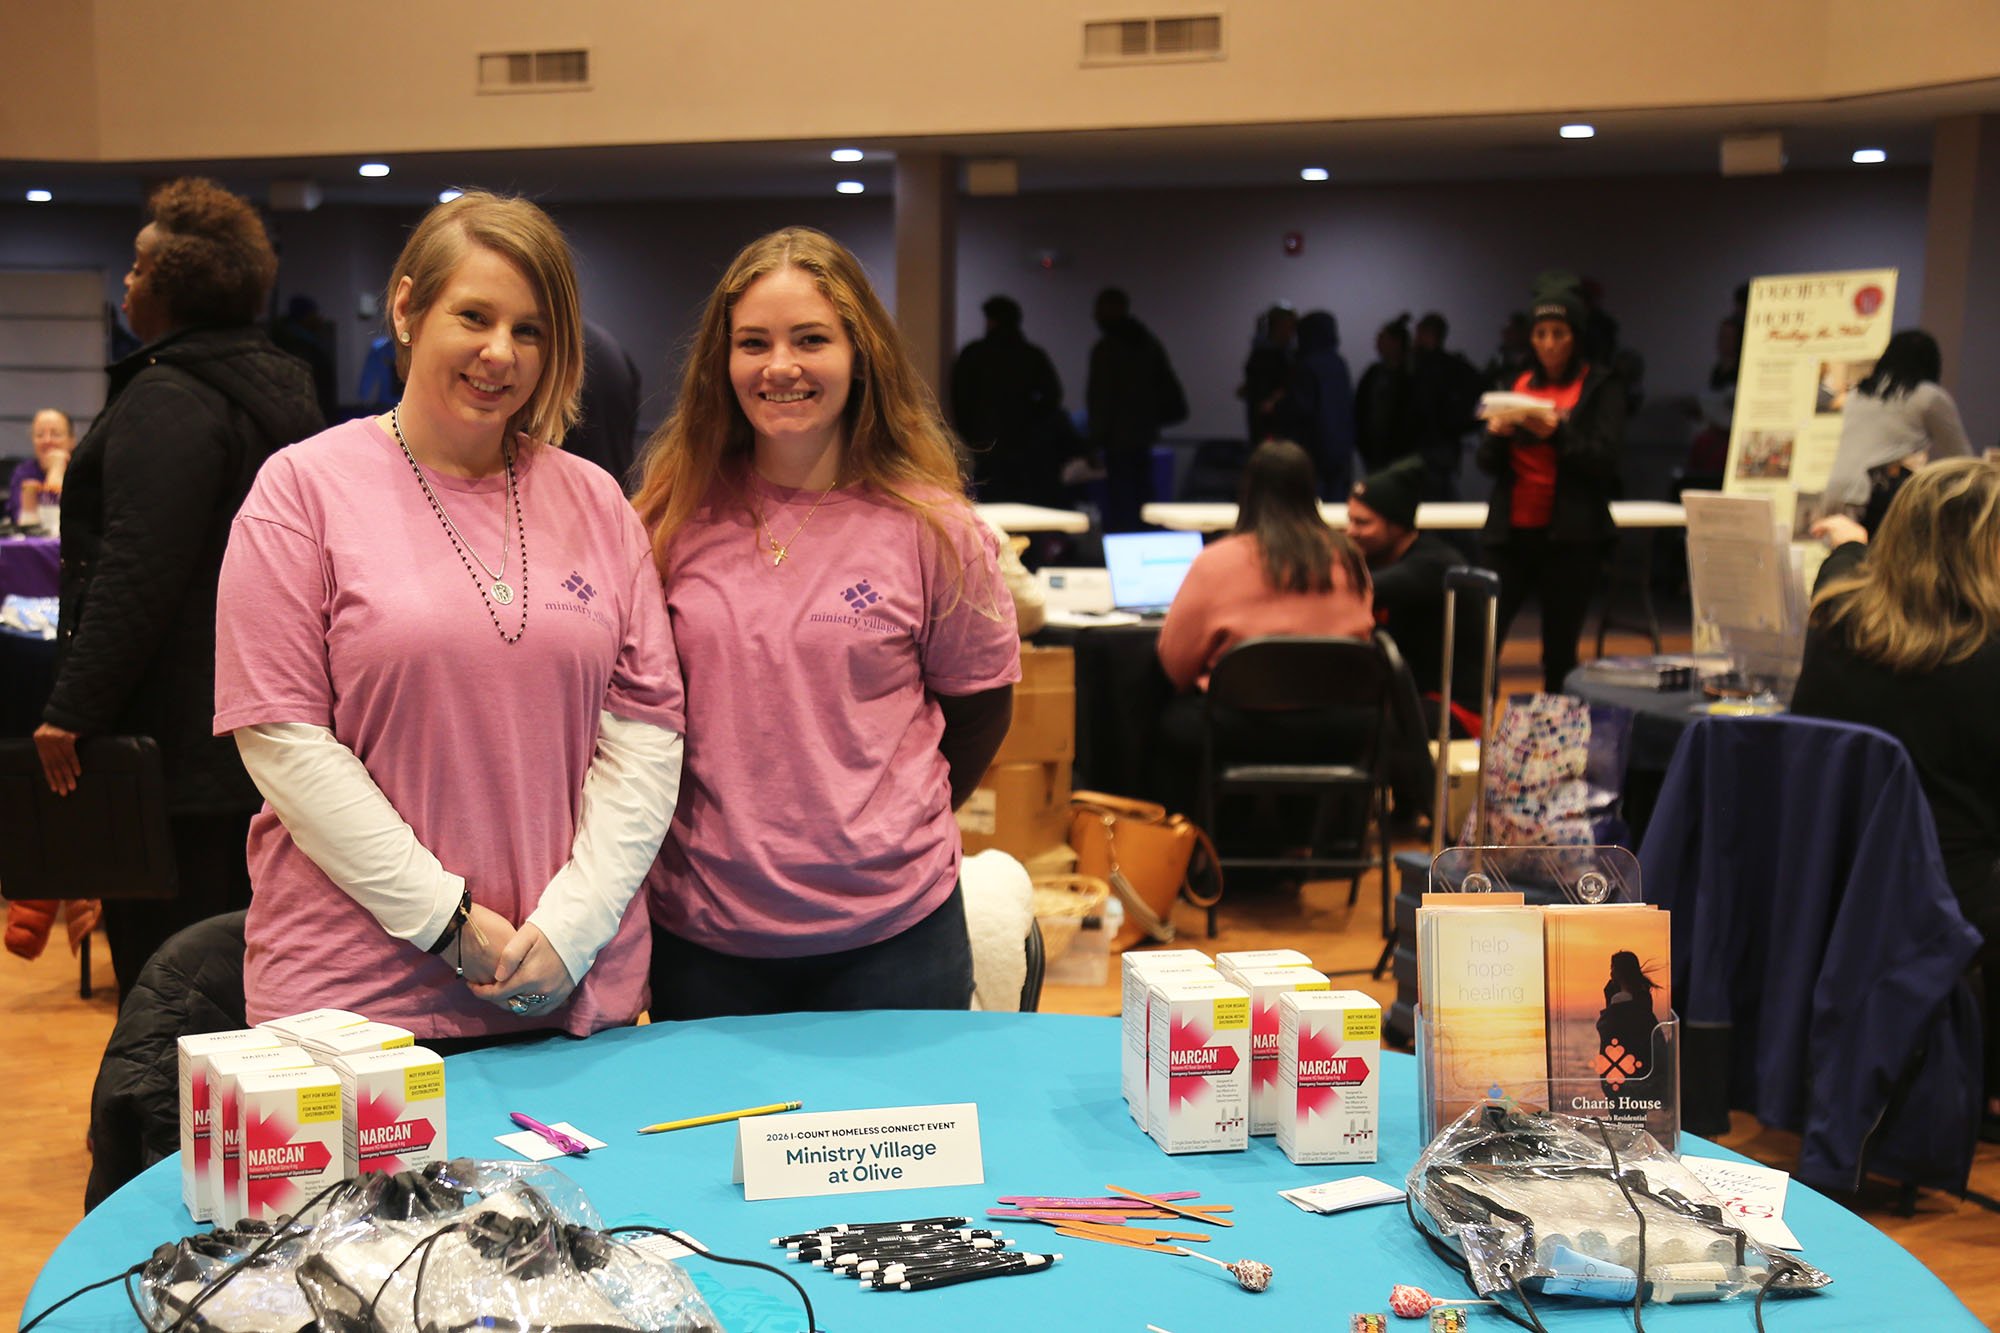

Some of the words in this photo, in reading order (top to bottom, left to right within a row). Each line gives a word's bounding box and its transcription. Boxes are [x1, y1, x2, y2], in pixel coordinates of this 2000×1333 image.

[545, 601, 592, 618] ministry
[810, 612, 860, 628] ministry
[863, 616, 898, 633] village
[1471, 935, 1509, 955] help
[1467, 960, 1514, 980] hope
[1458, 984, 1524, 1004] healing
[1171, 1049, 1217, 1065] NARCAN
[1299, 1059, 1347, 1075] NARCAN
[1571, 1096, 1615, 1110] Charis
[1618, 1096, 1662, 1110] House
[360, 1123, 412, 1146] NARCAN
[767, 1133, 789, 1142] 2026
[790, 1130, 830, 1140] I-COUNT
[832, 1126, 880, 1137] HOMELESS
[881, 1123, 925, 1134] CONNECT
[927, 1121, 956, 1131] EVENT
[248, 1145, 305, 1167] NARCAN
[786, 1146, 866, 1165] Ministry
[870, 1141, 937, 1161] Village
[828, 1167, 849, 1184] at
[852, 1164, 903, 1182] Olive
